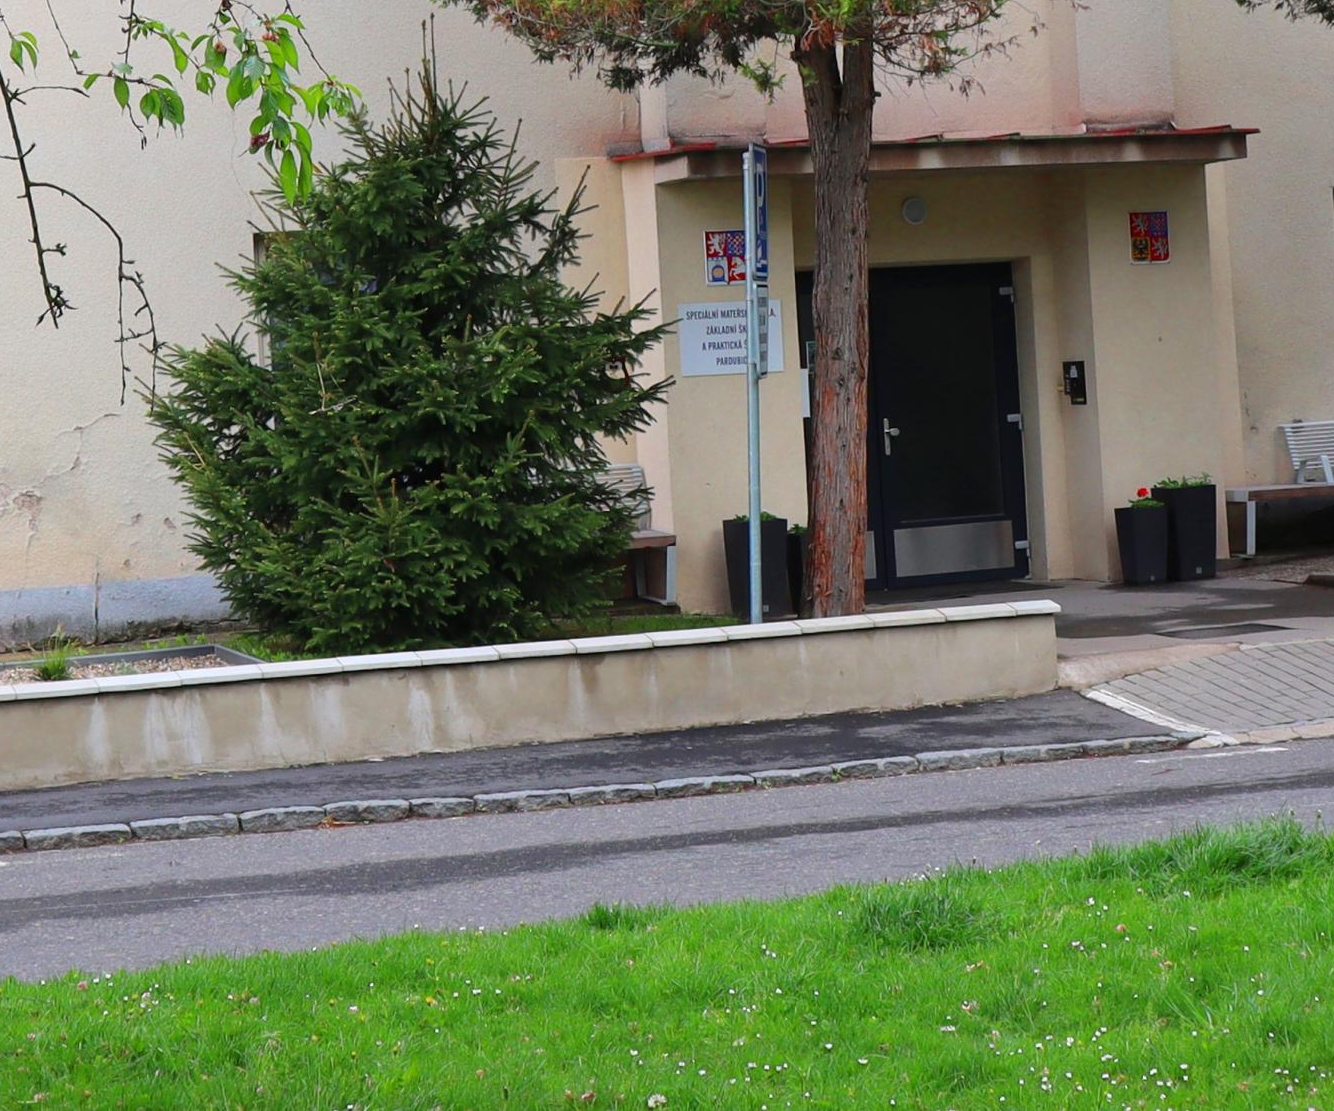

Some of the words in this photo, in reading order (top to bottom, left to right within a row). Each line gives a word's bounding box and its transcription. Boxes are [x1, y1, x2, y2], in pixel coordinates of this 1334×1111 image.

[686, 308, 718, 320] SPECIÁLNÍ
[707, 324, 737, 335] ZÁKLADNÍ
[702, 342, 706, 350] A
[708, 339, 742, 350] PRAKTICKÁ
